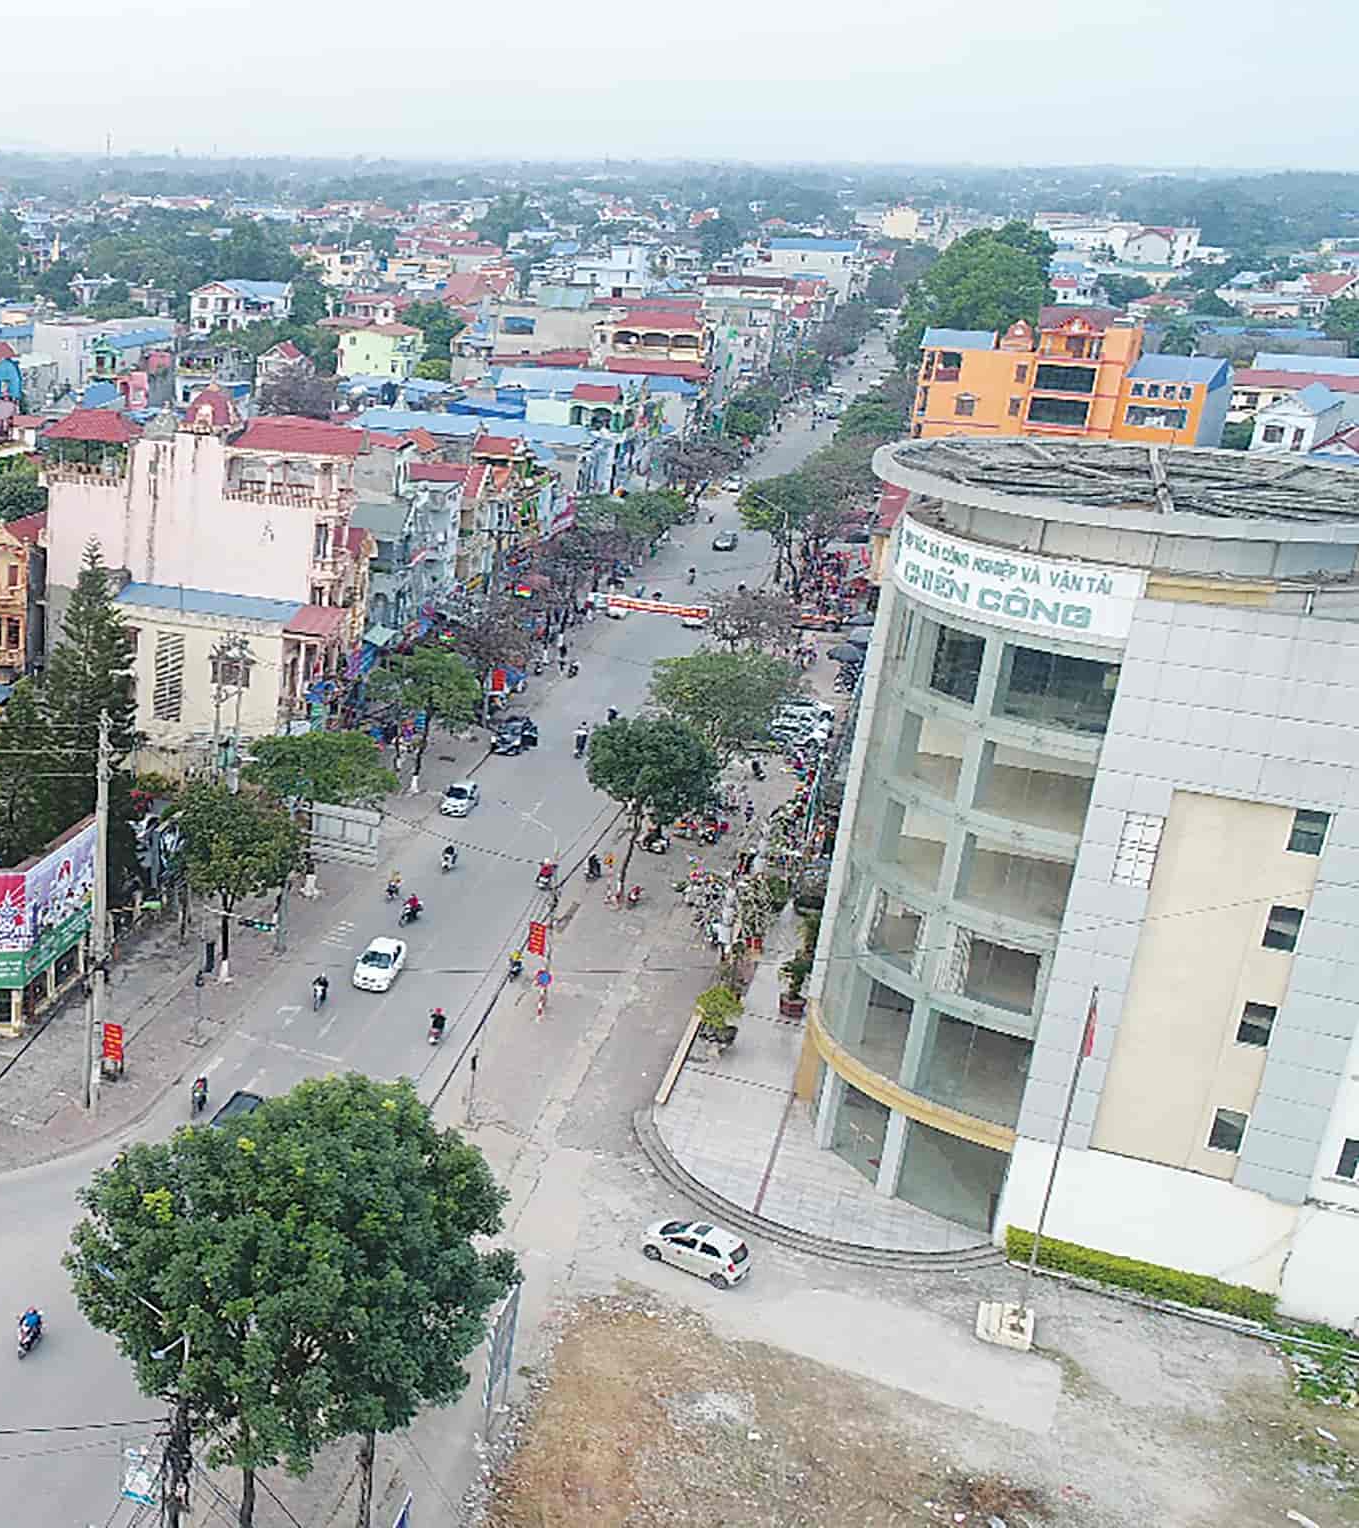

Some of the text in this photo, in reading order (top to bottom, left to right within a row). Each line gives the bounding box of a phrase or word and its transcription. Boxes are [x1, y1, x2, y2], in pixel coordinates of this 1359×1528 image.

[903, 560, 1092, 629] CHIẾN CÔNG
[941, 544, 970, 569] CÔNG
[971, 556, 1019, 583] NGHIỆP
[1020, 564, 1042, 586] VÀ
[1049, 569, 1084, 594] VẬN
[1085, 572, 1114, 595] TẢI
